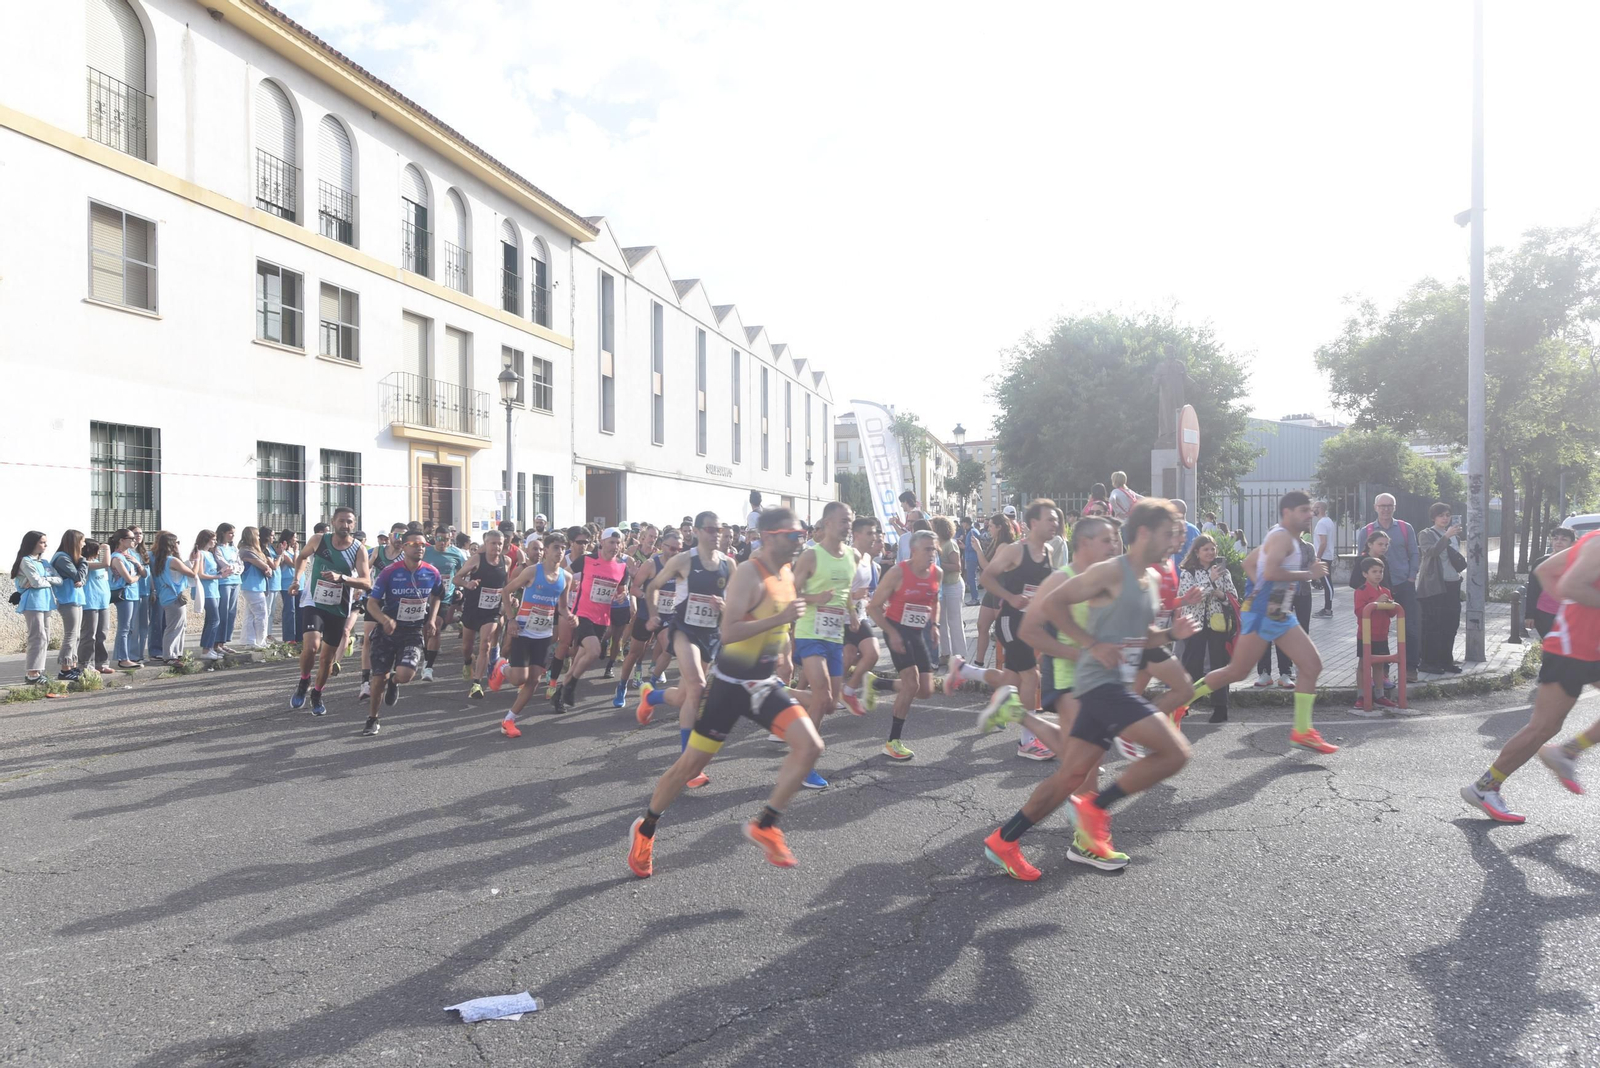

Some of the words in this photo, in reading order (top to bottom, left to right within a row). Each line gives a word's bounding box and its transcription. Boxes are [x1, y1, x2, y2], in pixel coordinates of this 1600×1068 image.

[323, 590, 334, 598] 34
[596, 587, 611, 596] 134
[404, 606, 422, 615] 494
[694, 605, 713, 617] 161
[533, 617, 549, 626] 337
[822, 616, 839, 627] 354
[908, 614, 926, 625] 358
